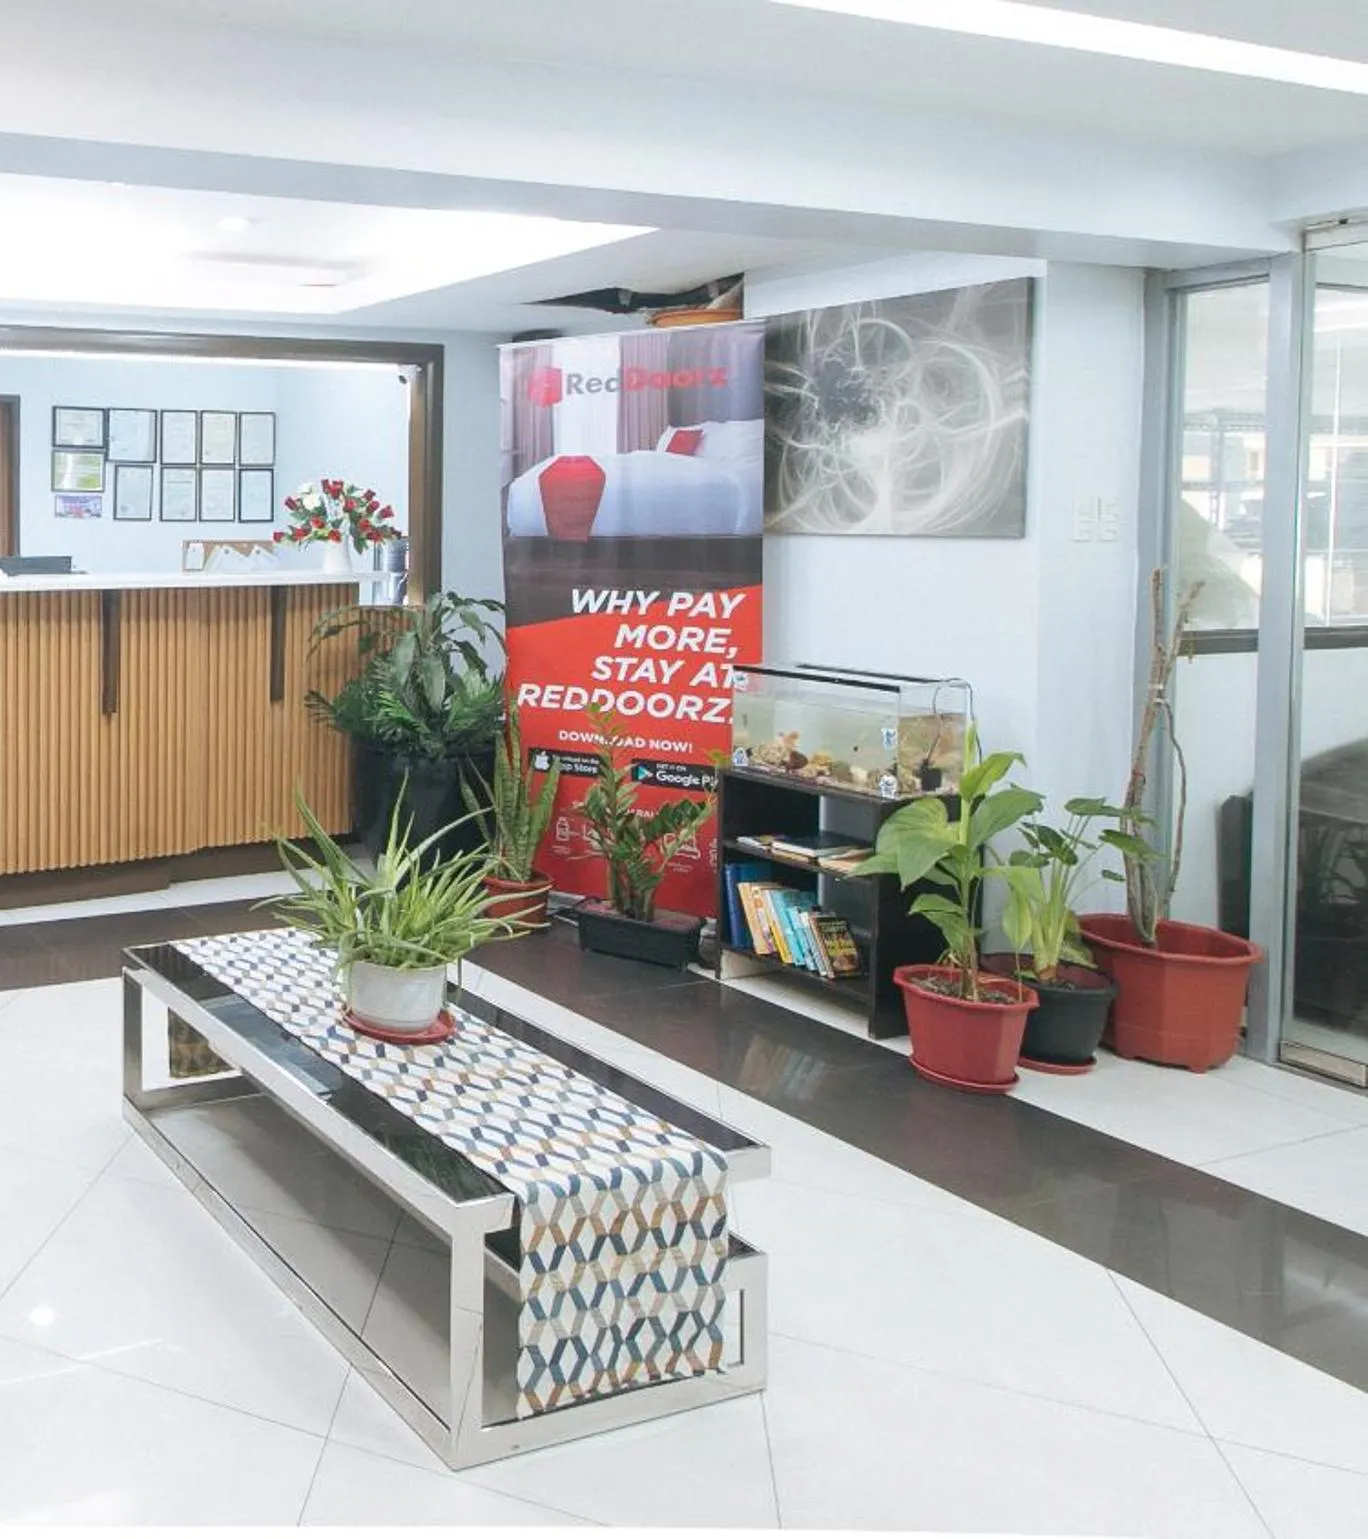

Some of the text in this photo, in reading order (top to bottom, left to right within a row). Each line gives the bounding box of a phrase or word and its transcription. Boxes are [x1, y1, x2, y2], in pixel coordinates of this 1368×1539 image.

[565, 367, 728, 395] RedDoorz
[572, 588, 746, 619] WHY PAY
[614, 624, 738, 658] MORE,
[591, 655, 734, 689] STAY AT
[558, 730, 693, 754] DOWNAD NOW!
[574, 763, 598, 774] Store
[656, 770, 700, 787] Google
